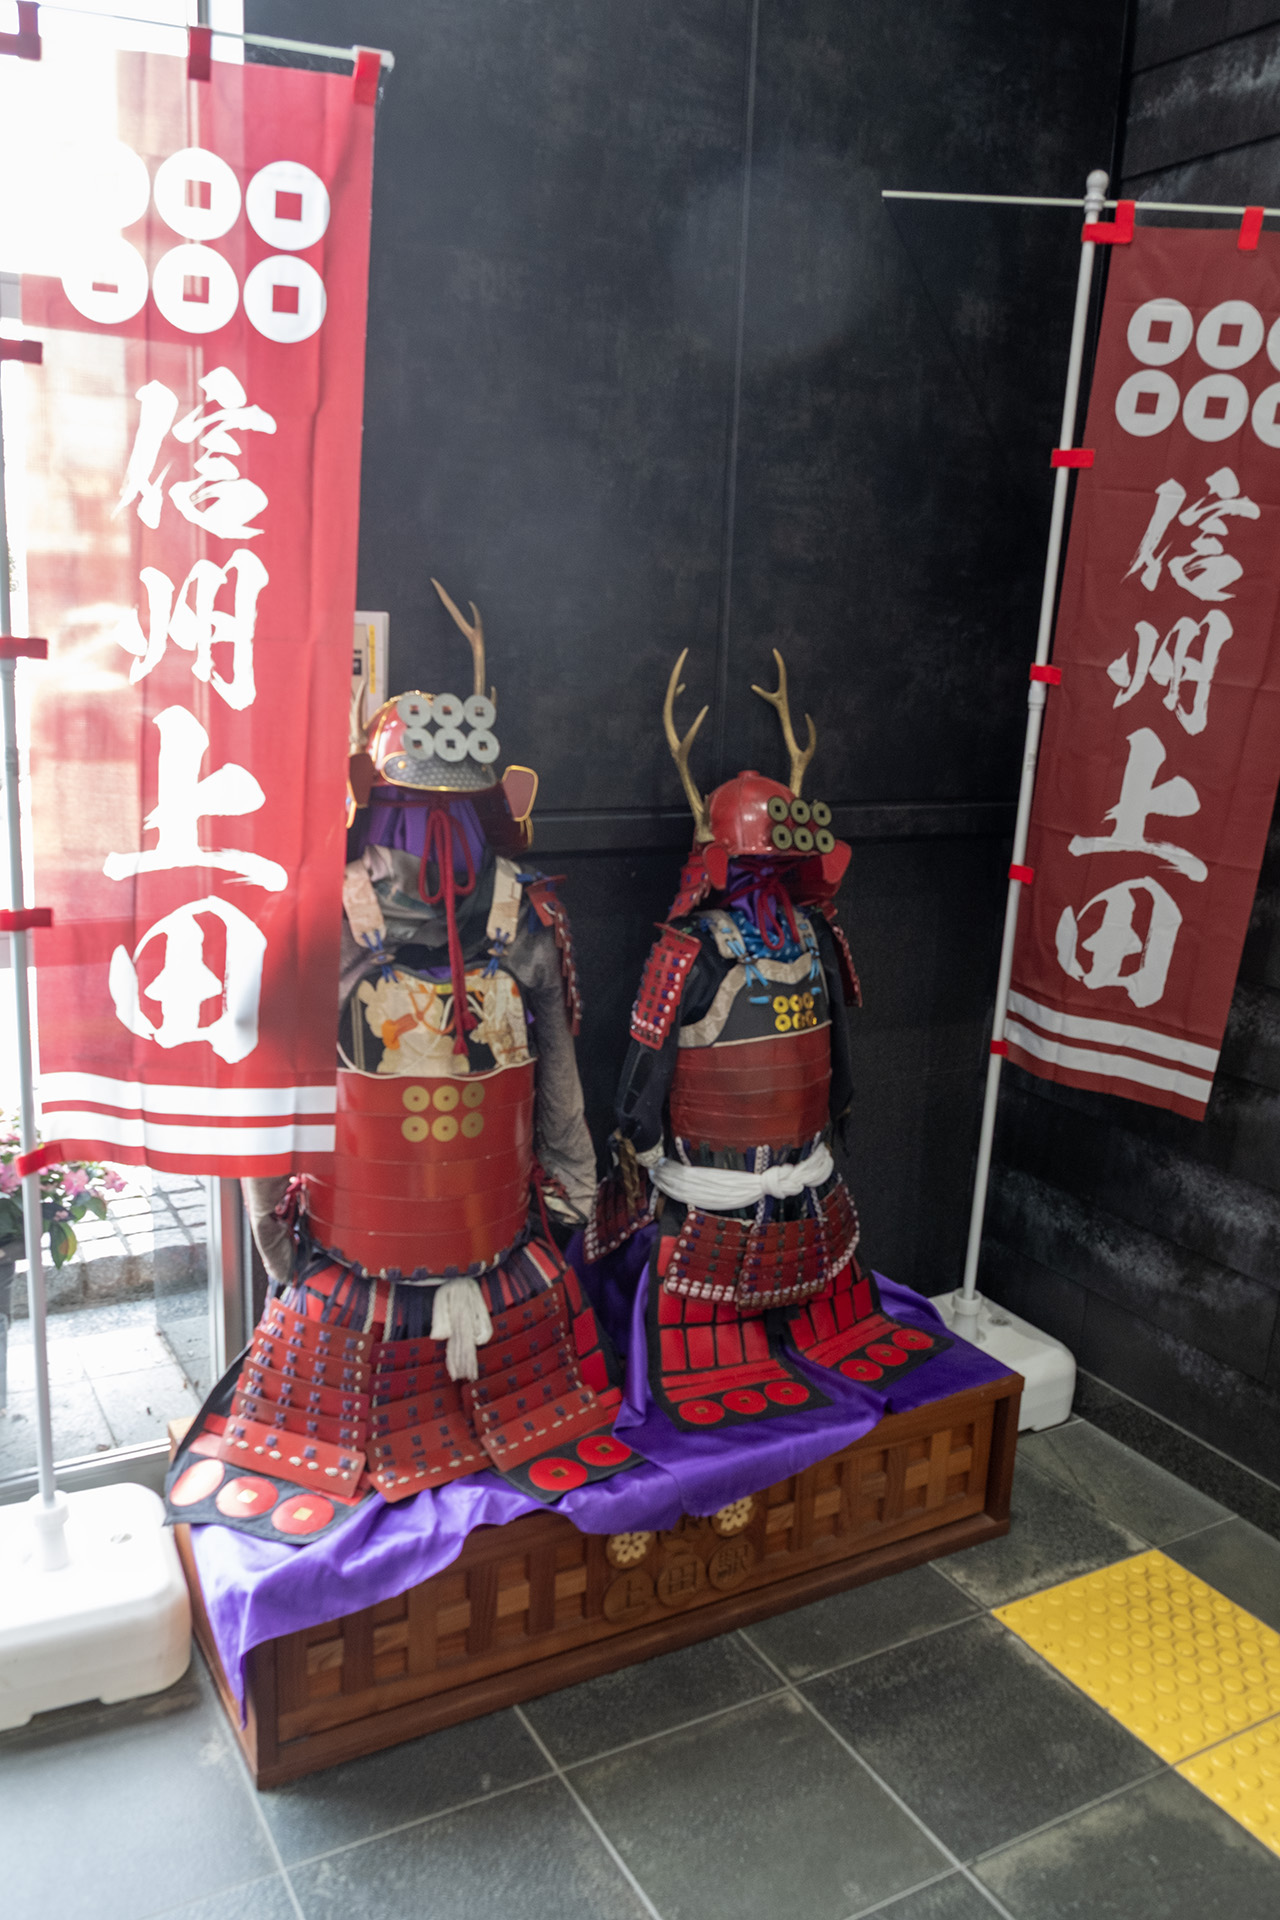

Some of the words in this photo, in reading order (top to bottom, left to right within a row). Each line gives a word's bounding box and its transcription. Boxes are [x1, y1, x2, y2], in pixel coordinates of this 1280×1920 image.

[103, 366, 288, 1064] 信州上田
[1055, 467, 1260, 1008] 信州上田
